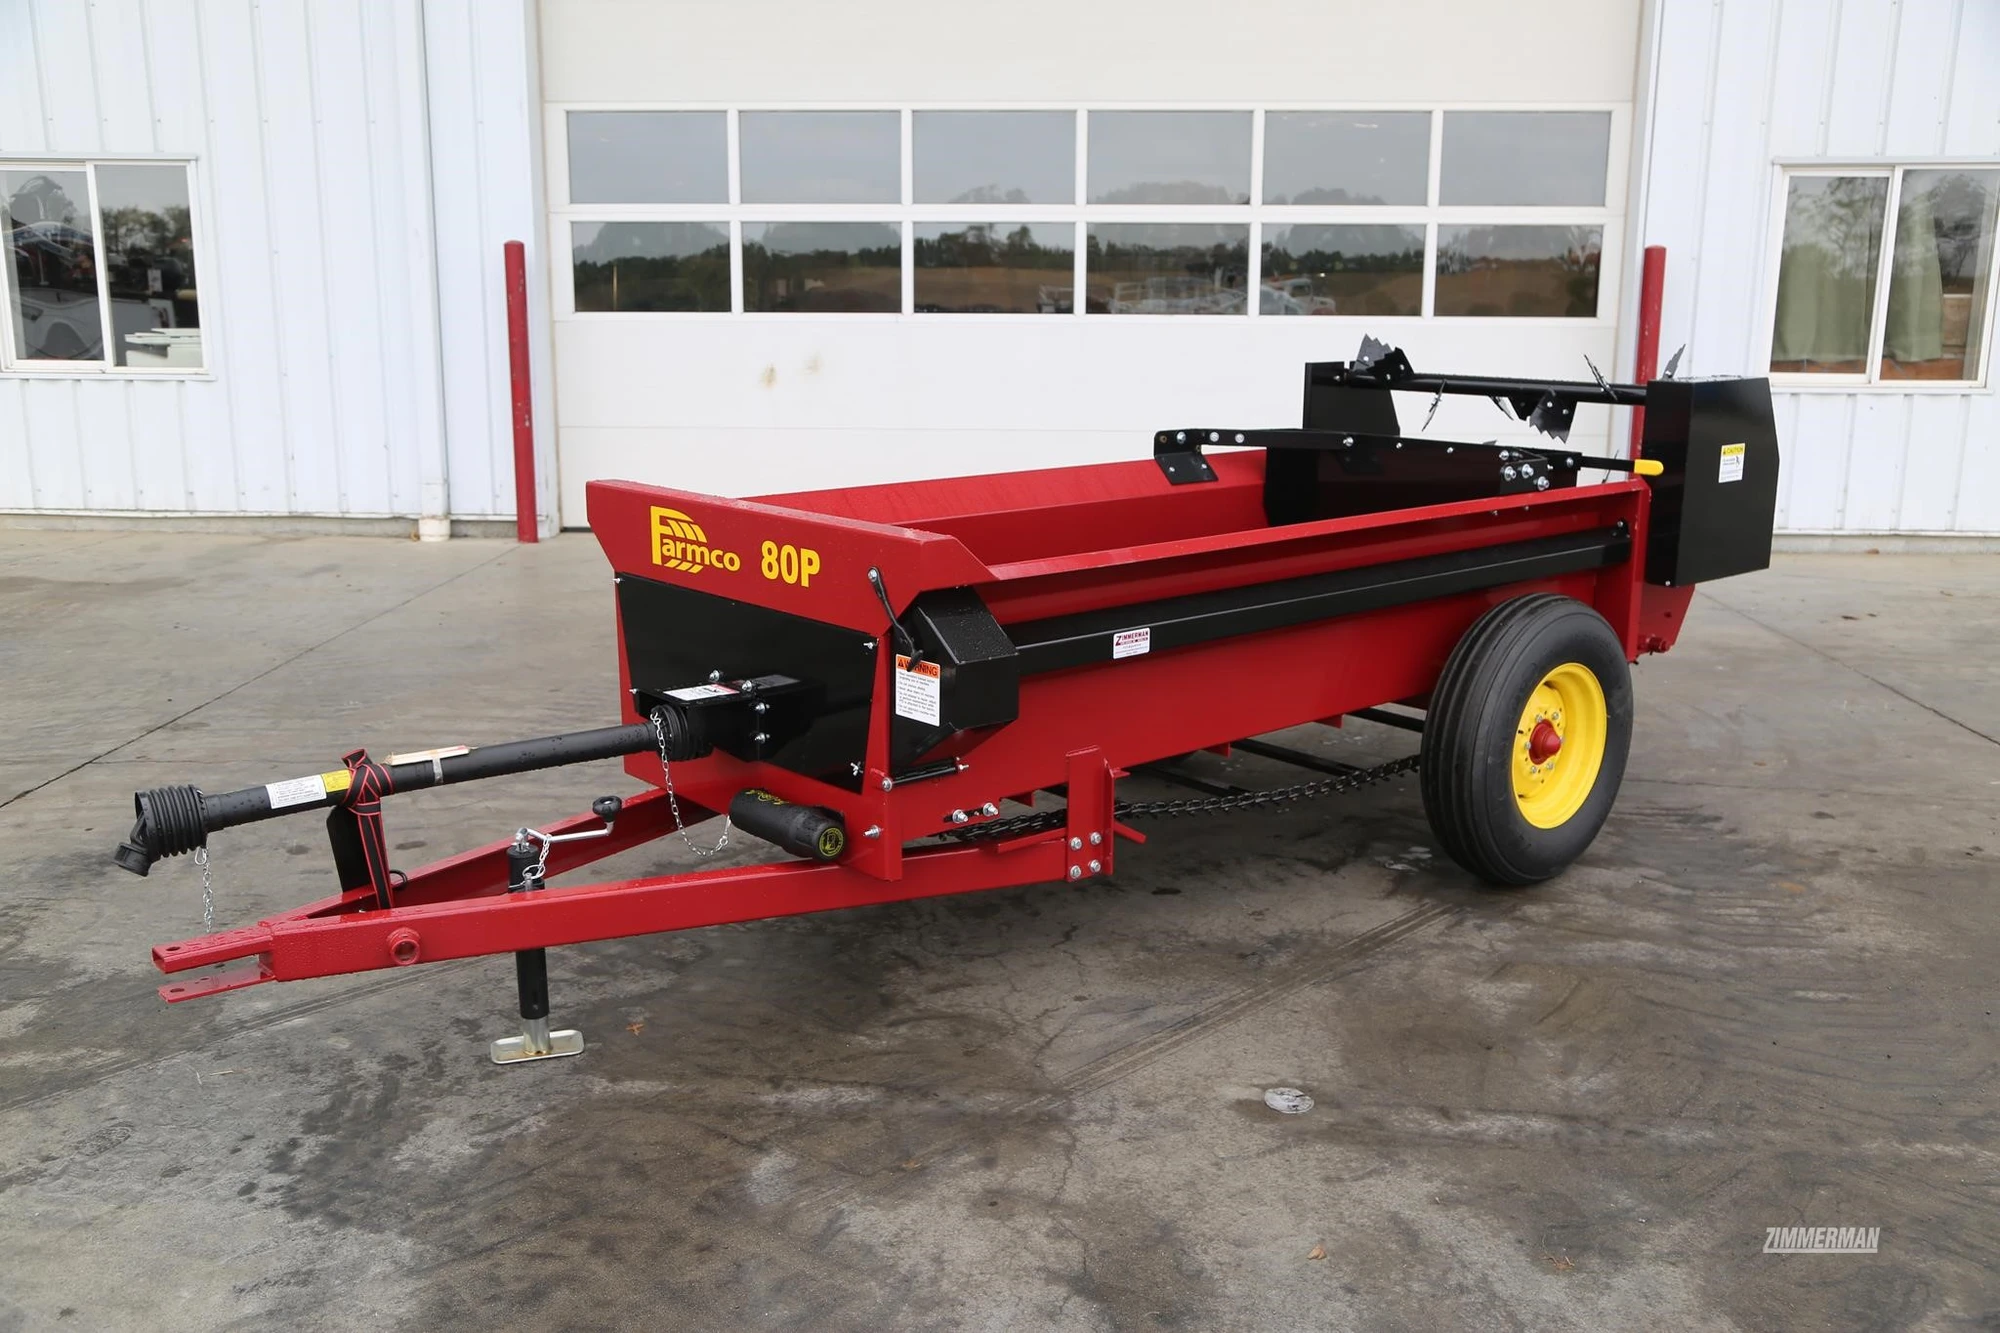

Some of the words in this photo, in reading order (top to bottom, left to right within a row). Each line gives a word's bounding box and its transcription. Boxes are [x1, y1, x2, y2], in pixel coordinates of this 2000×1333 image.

[650, 505, 741, 573] Farmco
[761, 540, 821, 588] 80P
[1115, 631, 1148, 646] ZIMMERMAN
